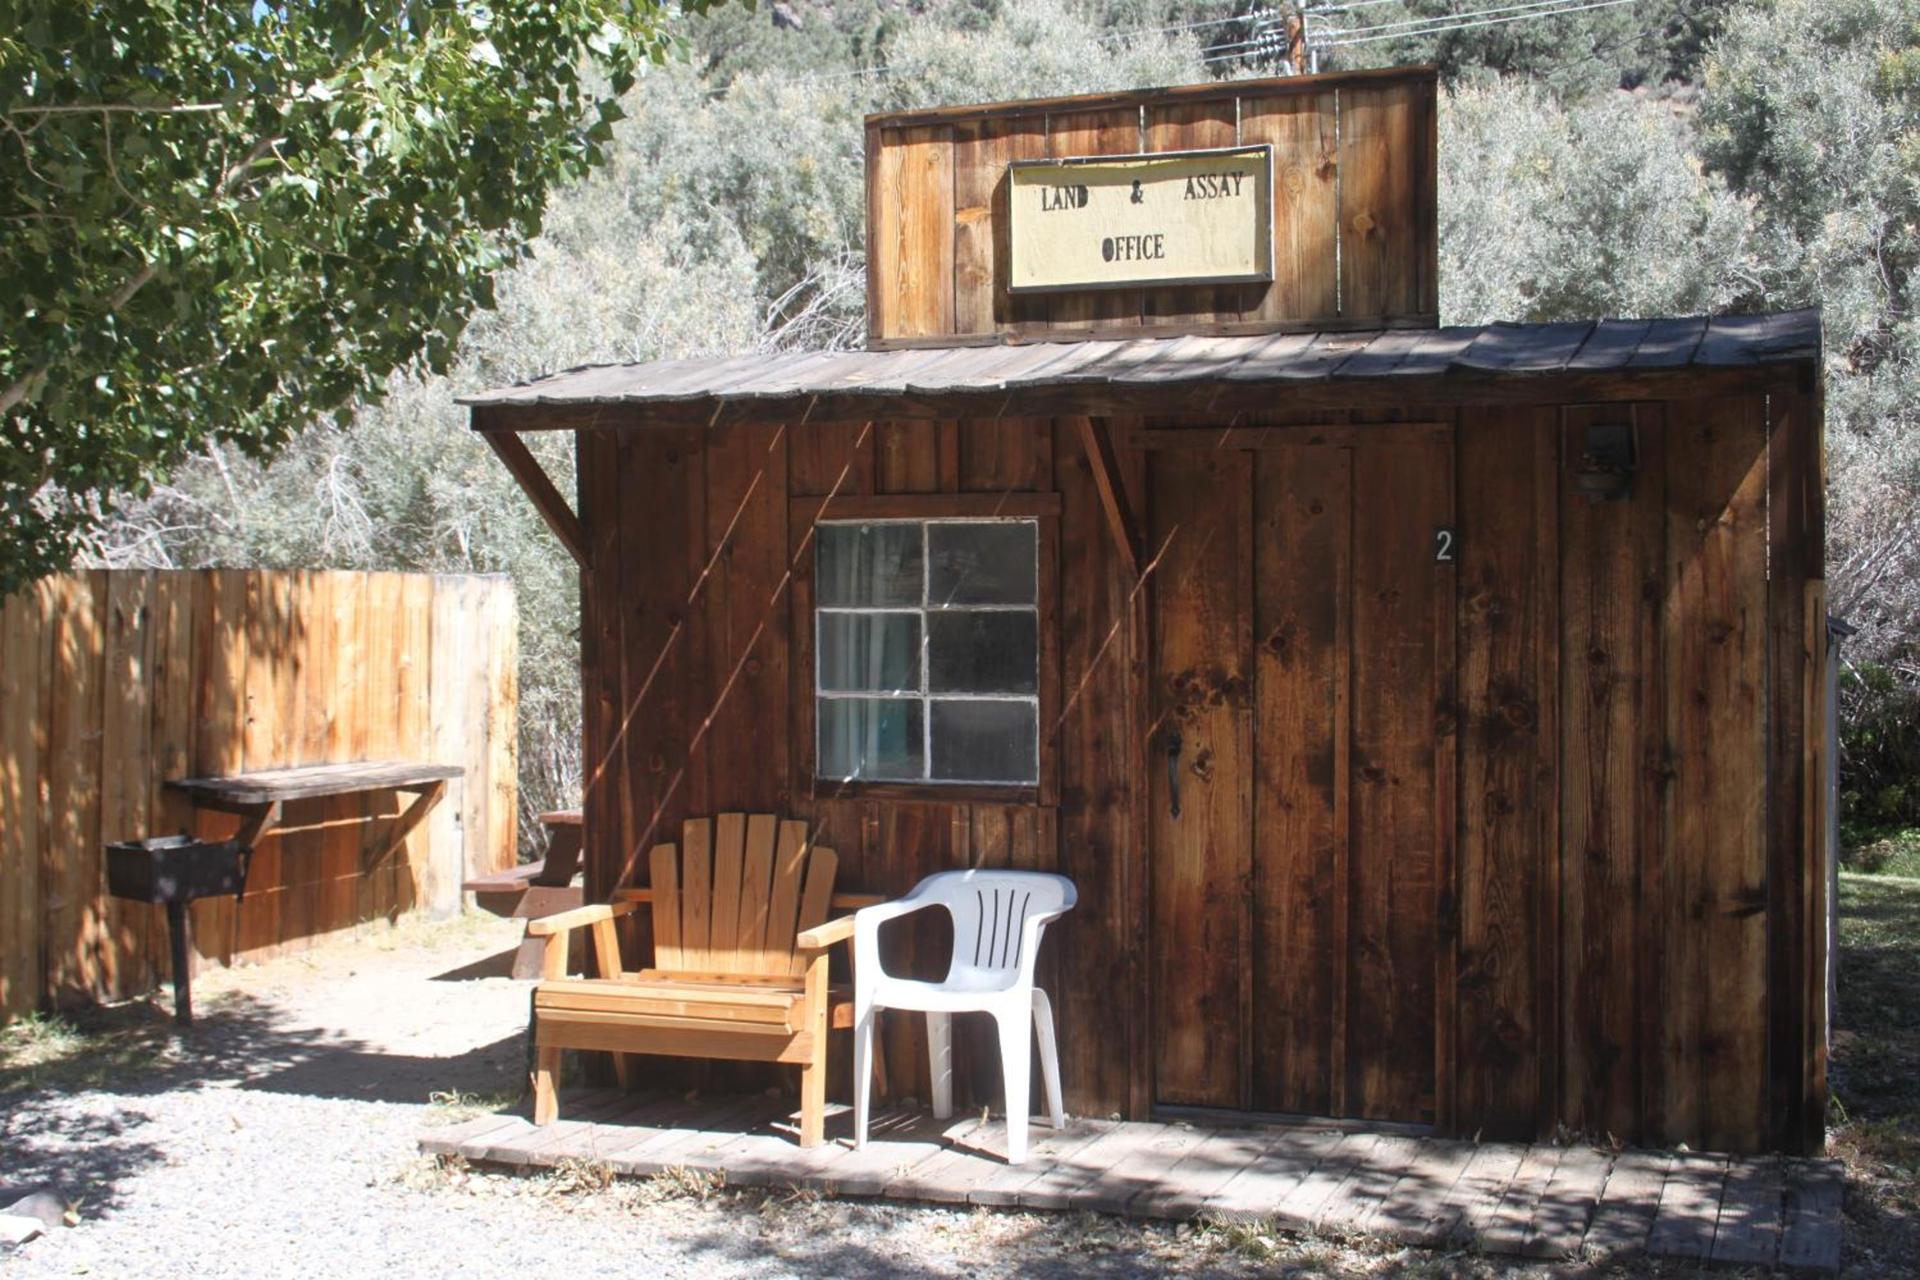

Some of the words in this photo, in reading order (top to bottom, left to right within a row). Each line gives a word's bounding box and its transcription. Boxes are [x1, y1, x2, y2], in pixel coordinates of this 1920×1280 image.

[1041, 184, 1089, 212] LAND
[1130, 179, 1144, 204] &
[1183, 171, 1244, 201] ASSAY
[1101, 234, 1165, 263] OFFICE
[1436, 530, 1452, 561] 2
